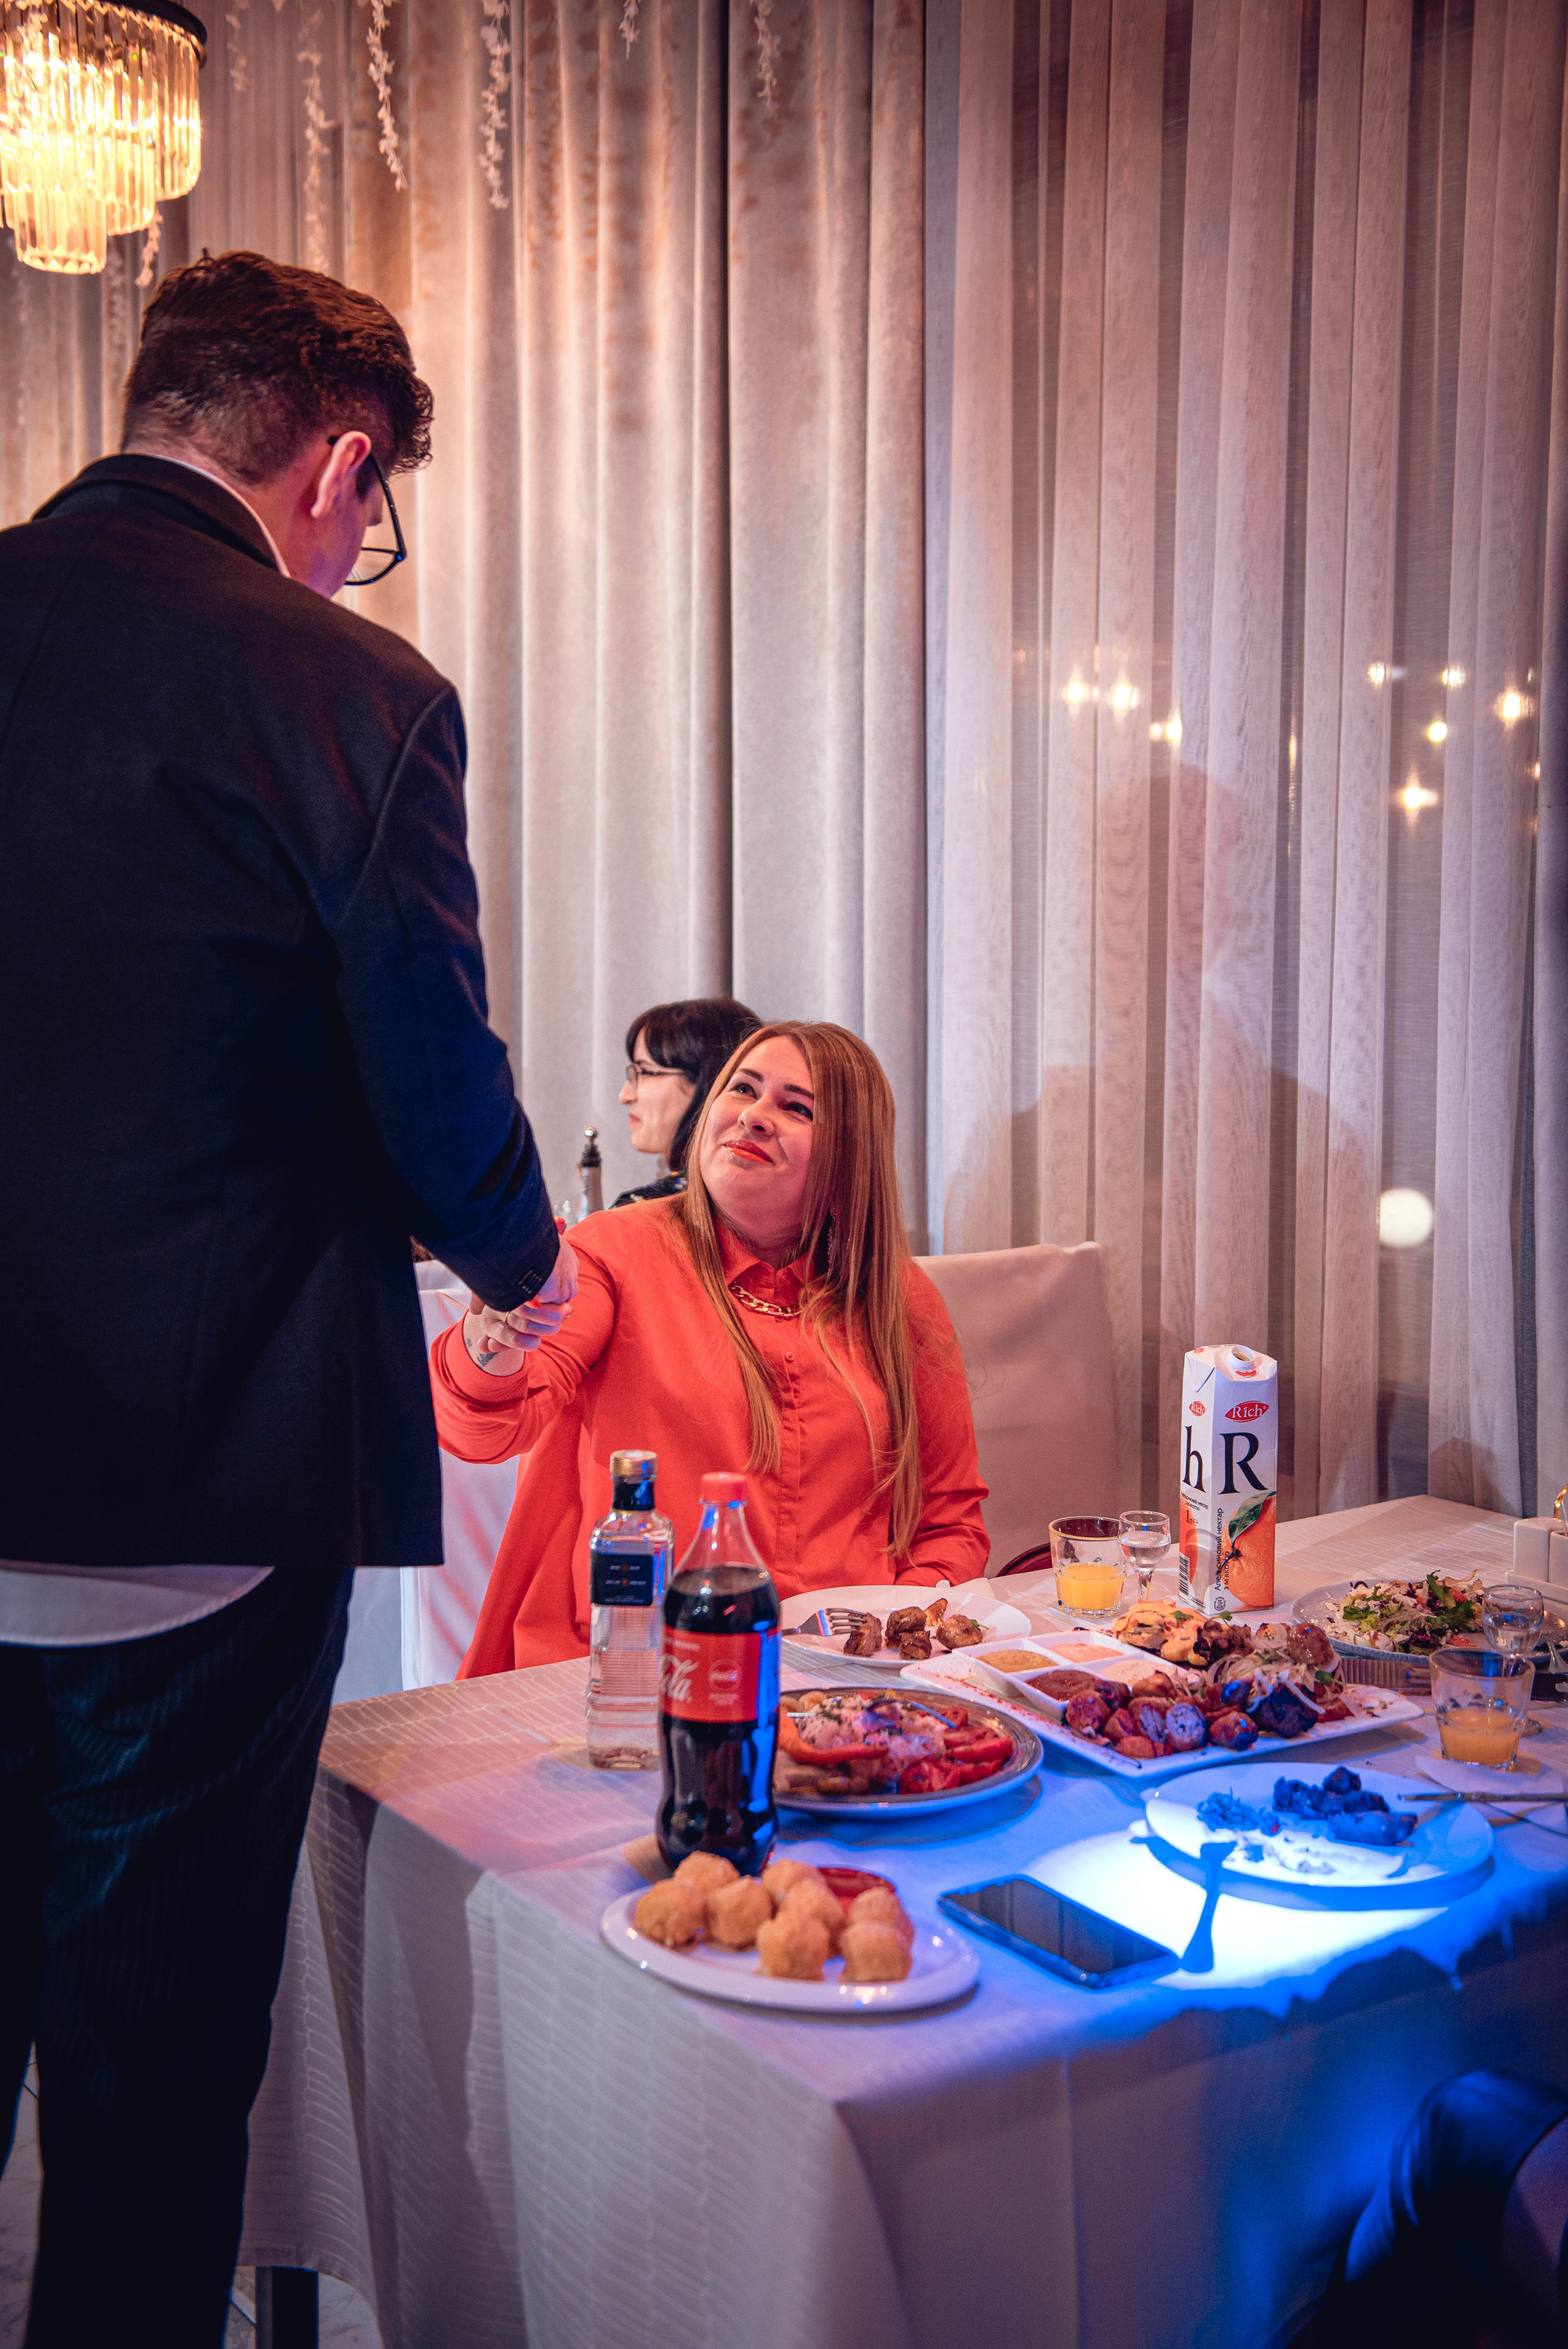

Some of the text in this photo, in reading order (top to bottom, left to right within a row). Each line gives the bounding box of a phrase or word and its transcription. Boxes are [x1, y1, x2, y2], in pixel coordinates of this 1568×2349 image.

[1191, 1402, 1204, 1415] Rich
[1231, 1404, 1264, 1418] Rich
[1182, 1424, 1206, 1493] h
[1218, 1432, 1268, 1495] R
